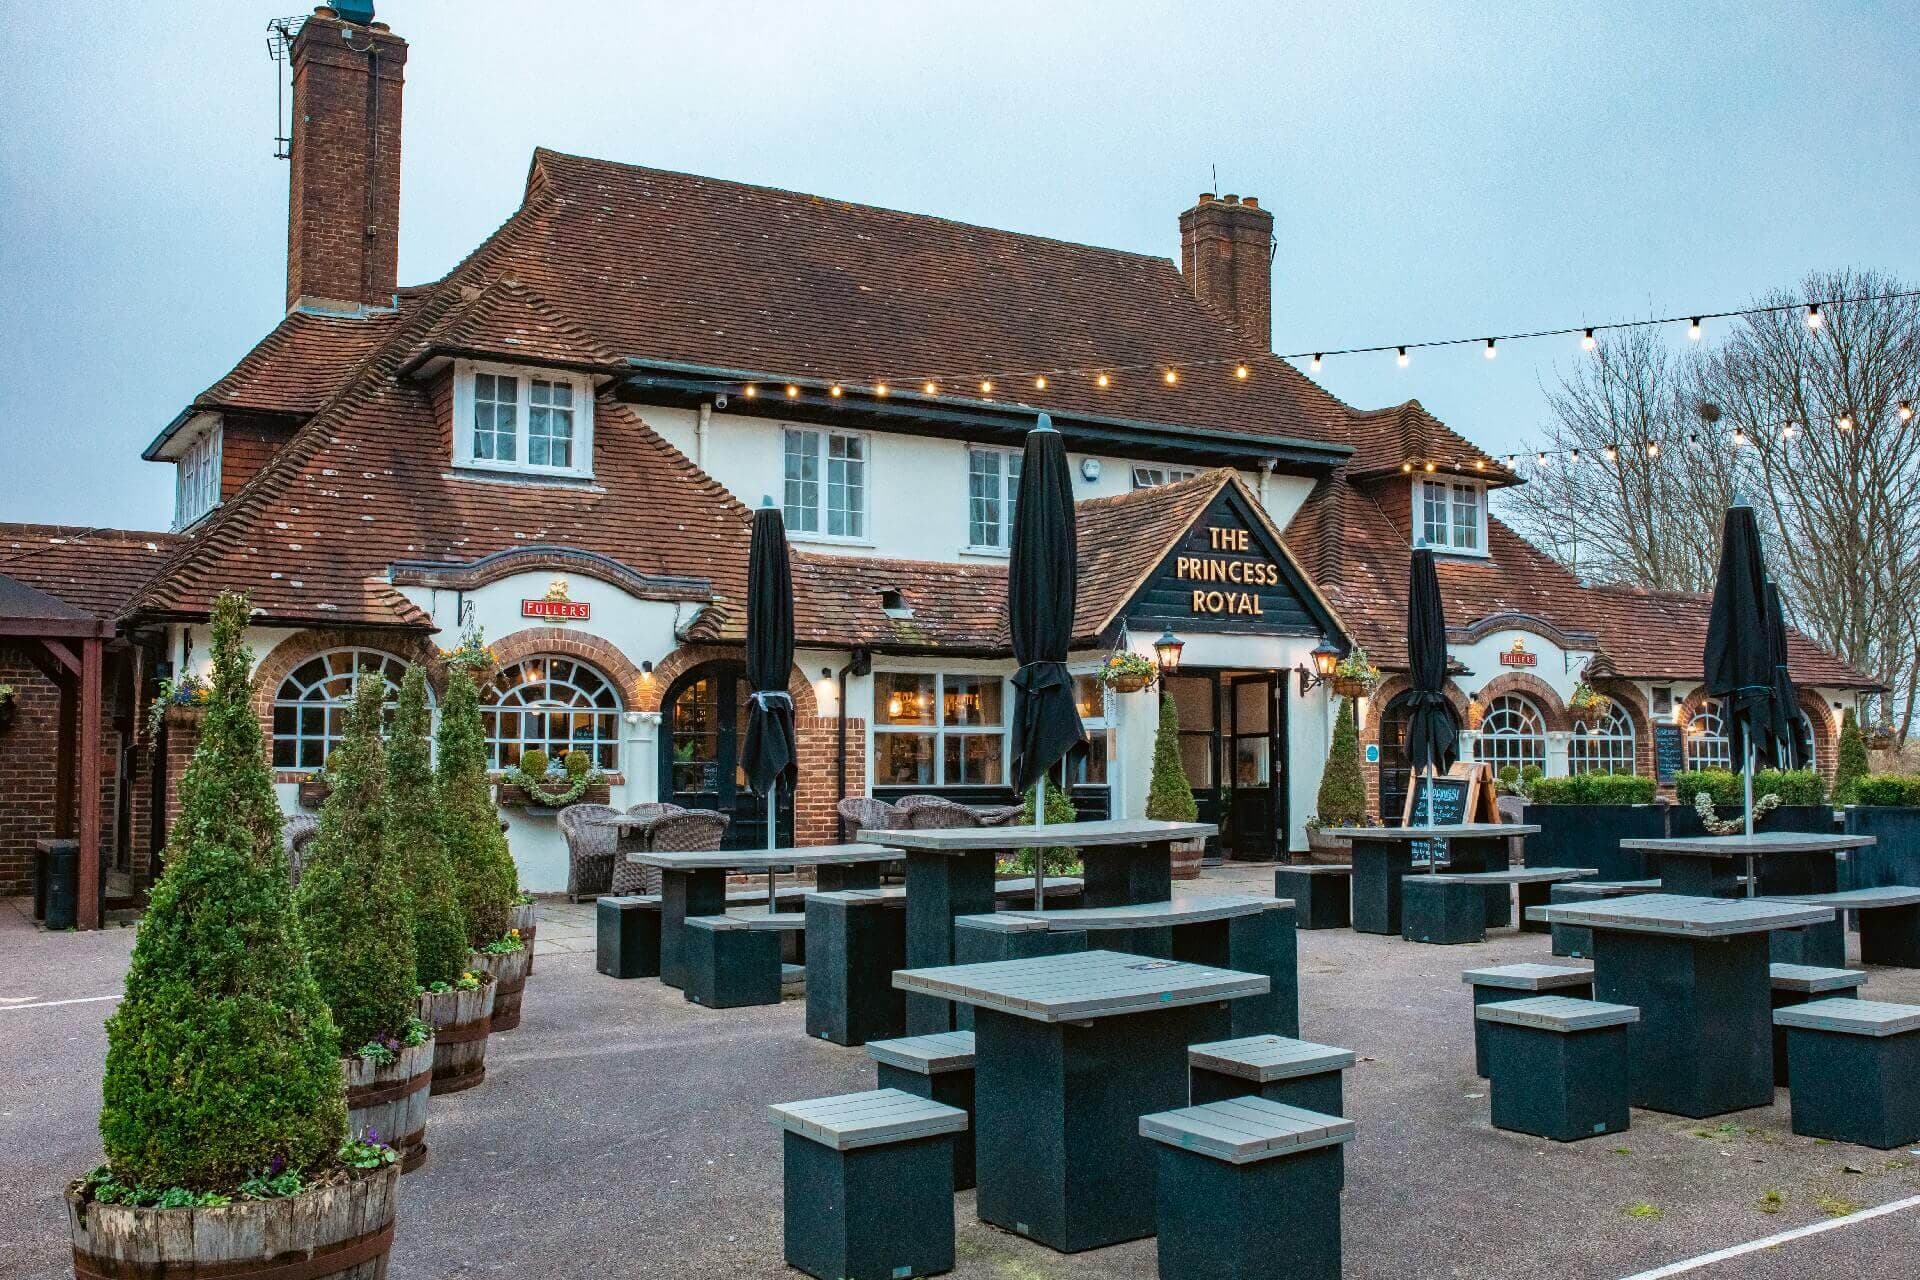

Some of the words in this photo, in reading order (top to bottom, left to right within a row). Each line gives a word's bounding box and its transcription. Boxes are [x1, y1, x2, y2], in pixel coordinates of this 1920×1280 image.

[1209, 527, 1249, 551] THE
[1177, 557, 1277, 585] PRINCESS
[1192, 590, 1264, 615] ROYAL
